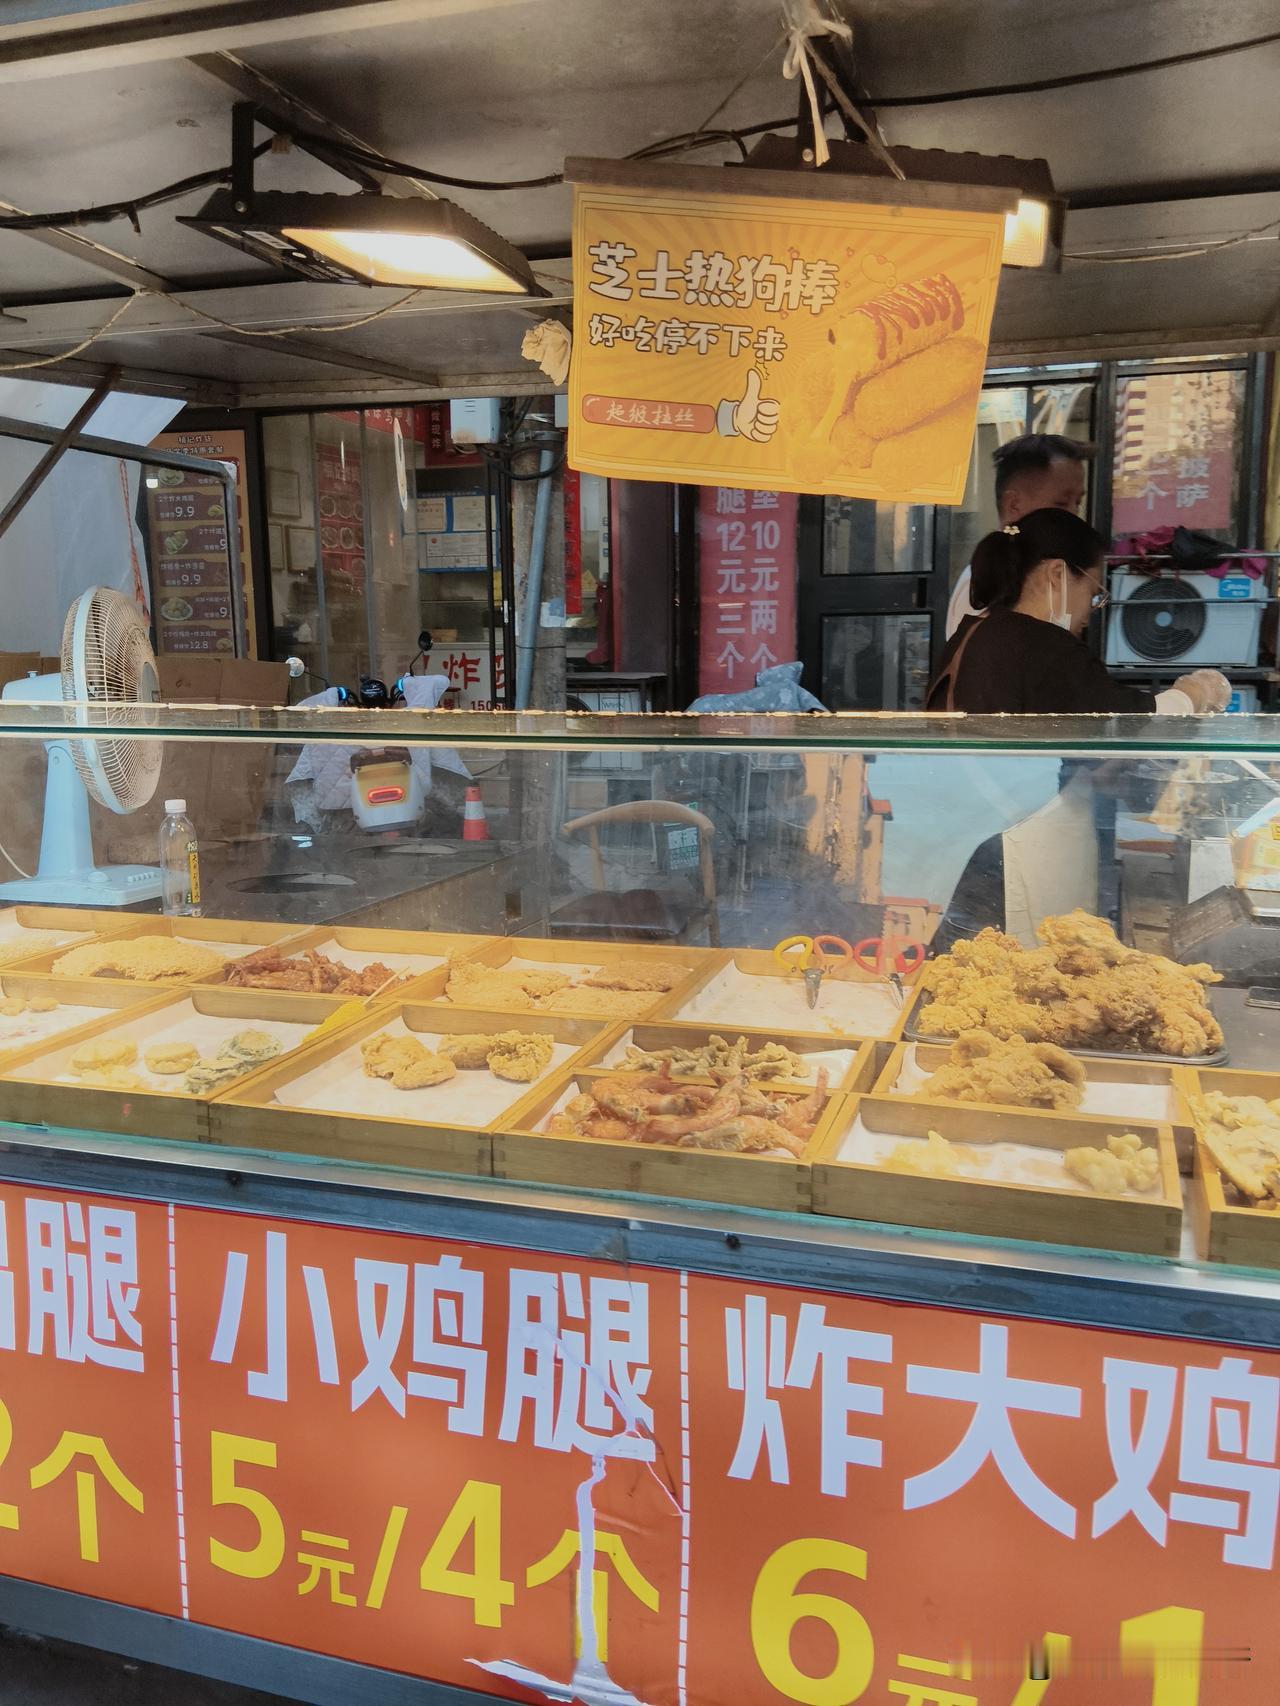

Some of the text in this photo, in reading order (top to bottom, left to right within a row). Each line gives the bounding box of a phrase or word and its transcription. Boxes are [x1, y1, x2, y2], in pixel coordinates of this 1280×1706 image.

[588, 241, 840, 314] 芝士热狗棒
[588, 314, 788, 362] 好吃停不下来
[0, 1197, 145, 1373] 腿
[210, 1231, 656, 1461] 小鸡腿
[0, 1400, 145, 1563] 个
[725, 1294, 1280, 1570] 炸大鸡
[208, 1430, 659, 1663] 5元/4个
